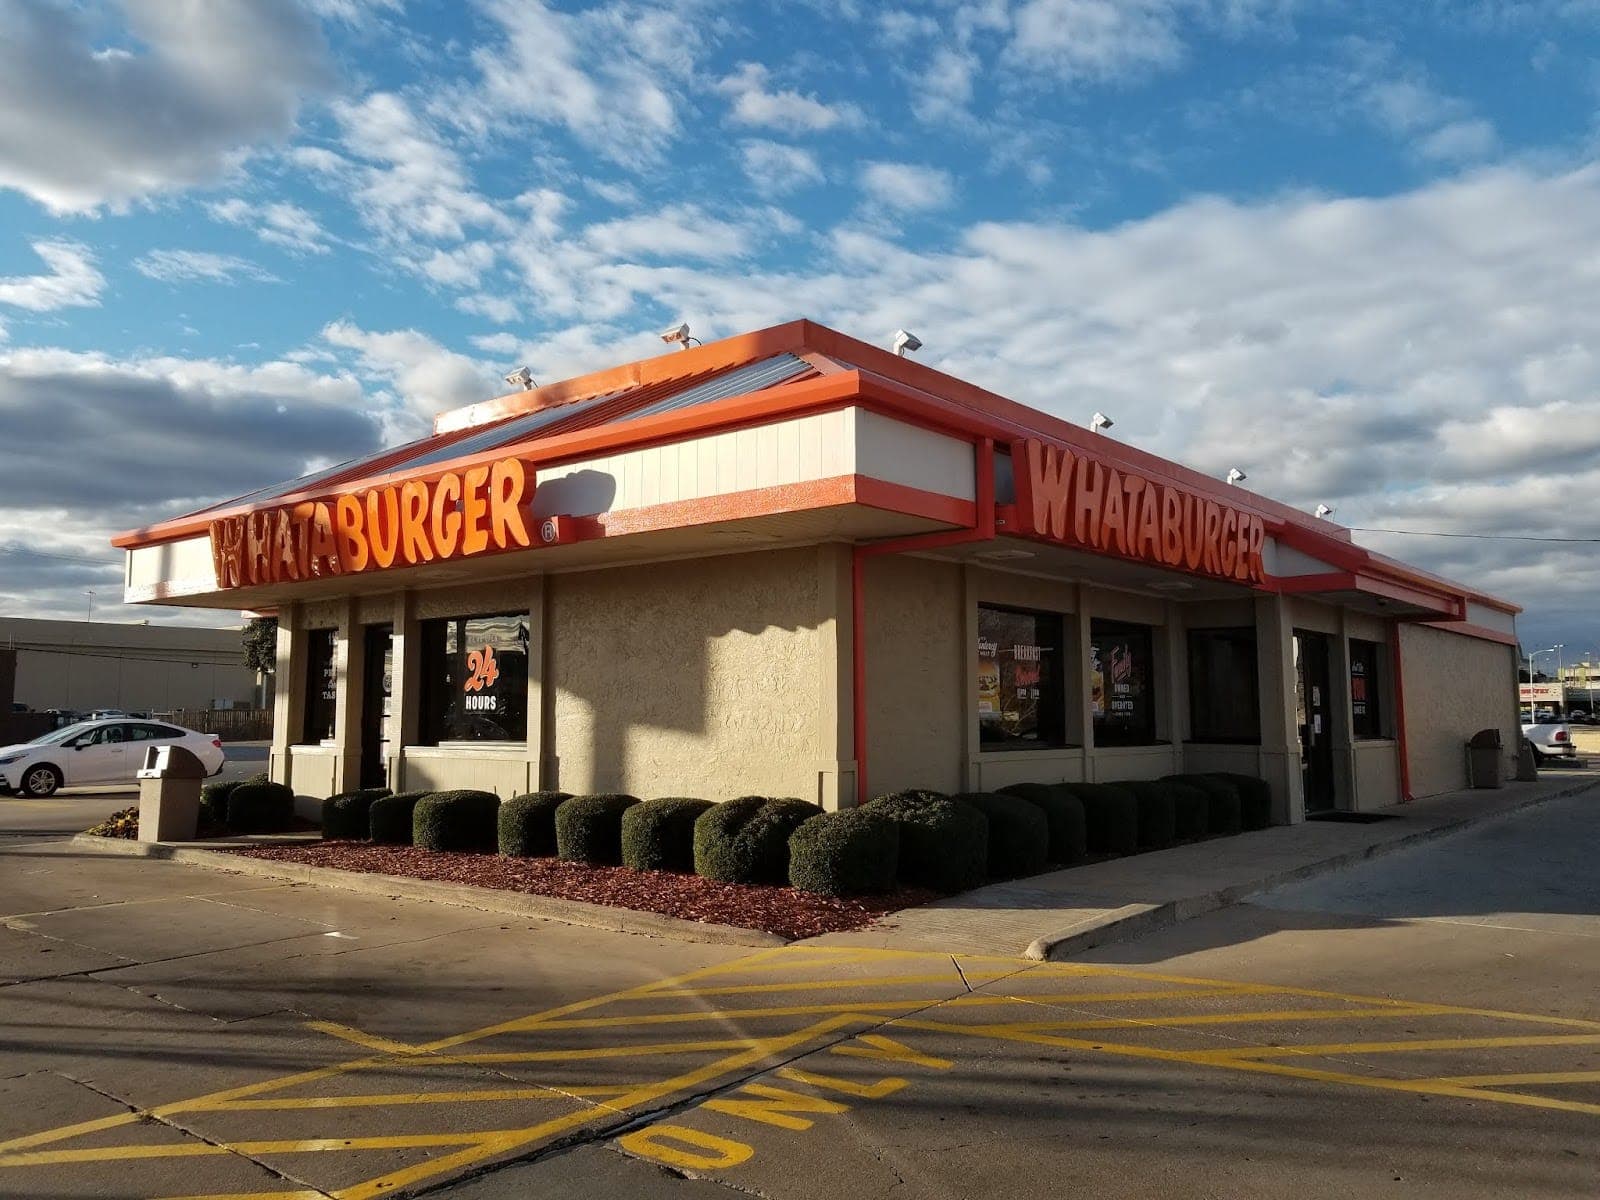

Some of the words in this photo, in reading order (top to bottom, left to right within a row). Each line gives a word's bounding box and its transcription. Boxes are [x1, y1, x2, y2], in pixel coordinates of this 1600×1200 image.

[209, 458, 531, 588] WHATABURGER
[1025, 438, 1265, 583] WHATABURGER
[464, 645, 499, 692] 24
[465, 695, 497, 710] HOURS
[620, 1034, 953, 1169] ONLY
